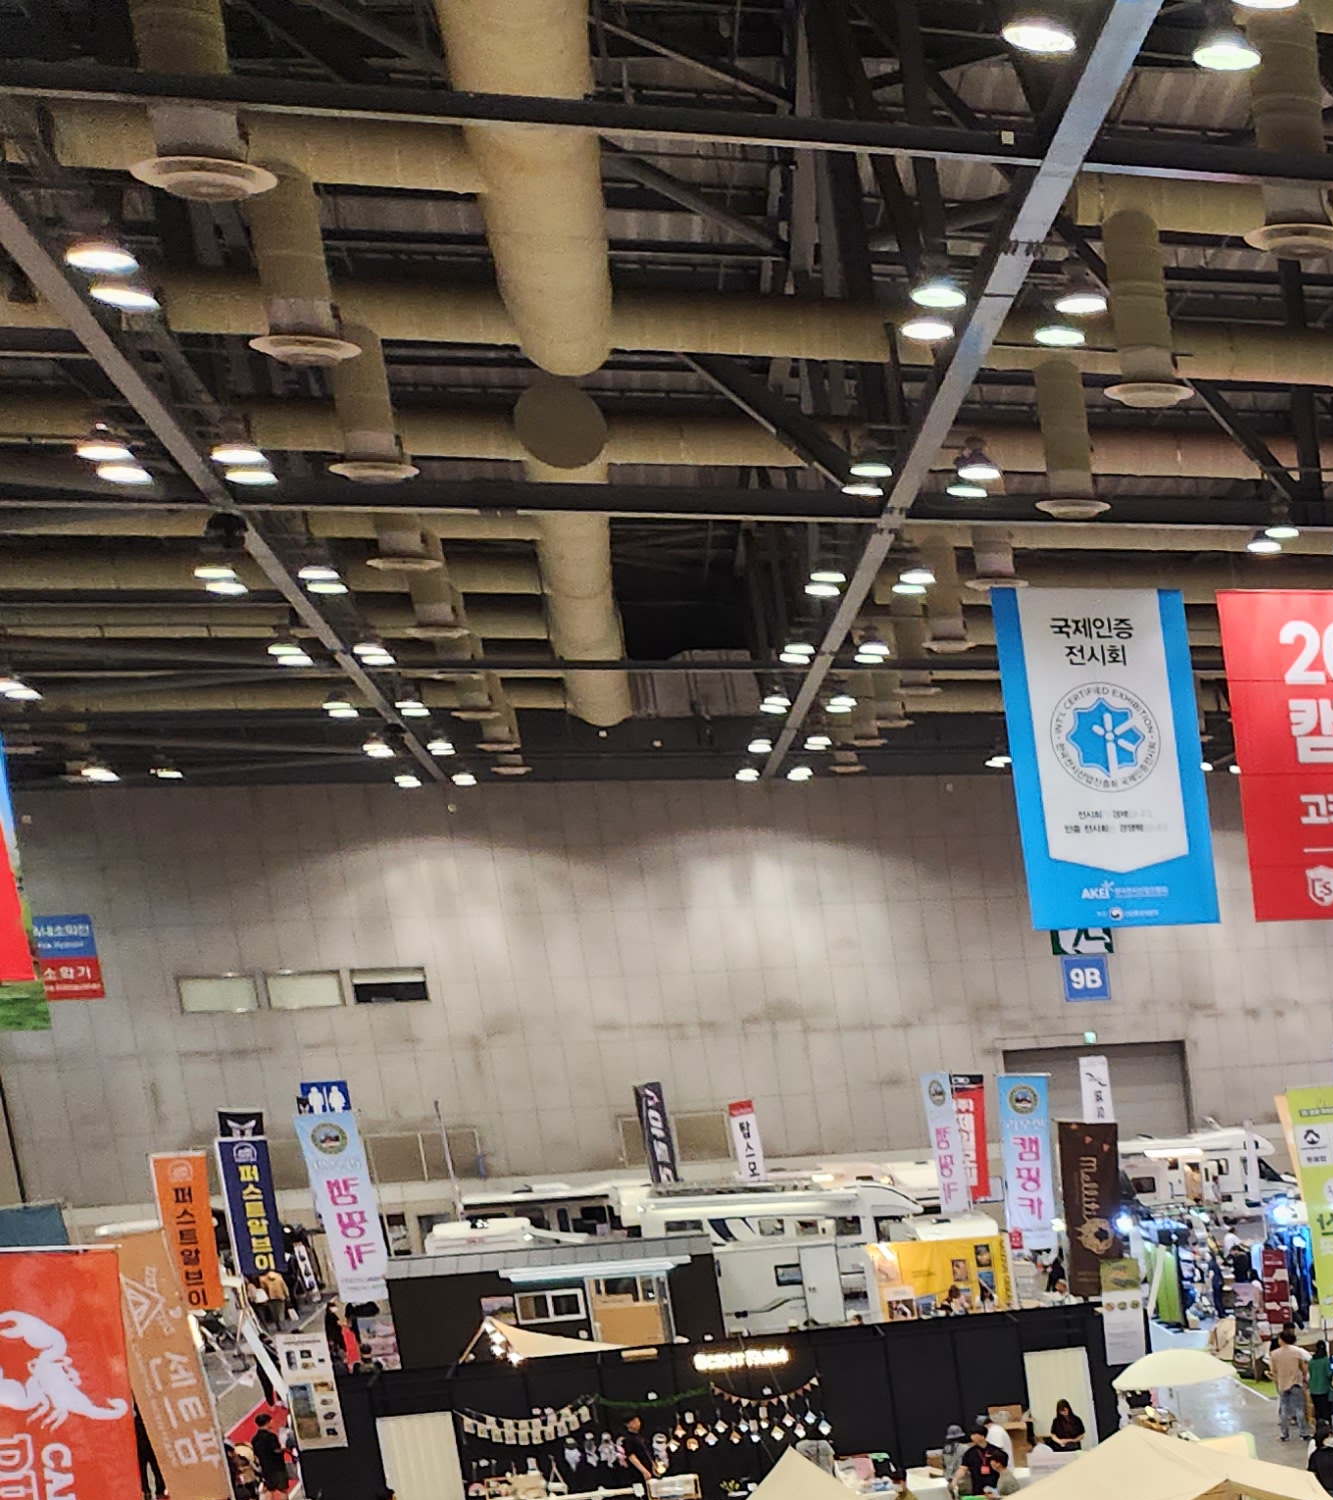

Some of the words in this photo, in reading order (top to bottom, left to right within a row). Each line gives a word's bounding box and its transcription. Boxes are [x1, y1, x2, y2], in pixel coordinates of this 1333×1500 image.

[1050, 617, 1134, 640] 국제인증
[1065, 645, 1127, 667] 전시회
[1070, 966, 1102, 992] 9B
[1013, 1136, 1044, 1220] 캠핑카
